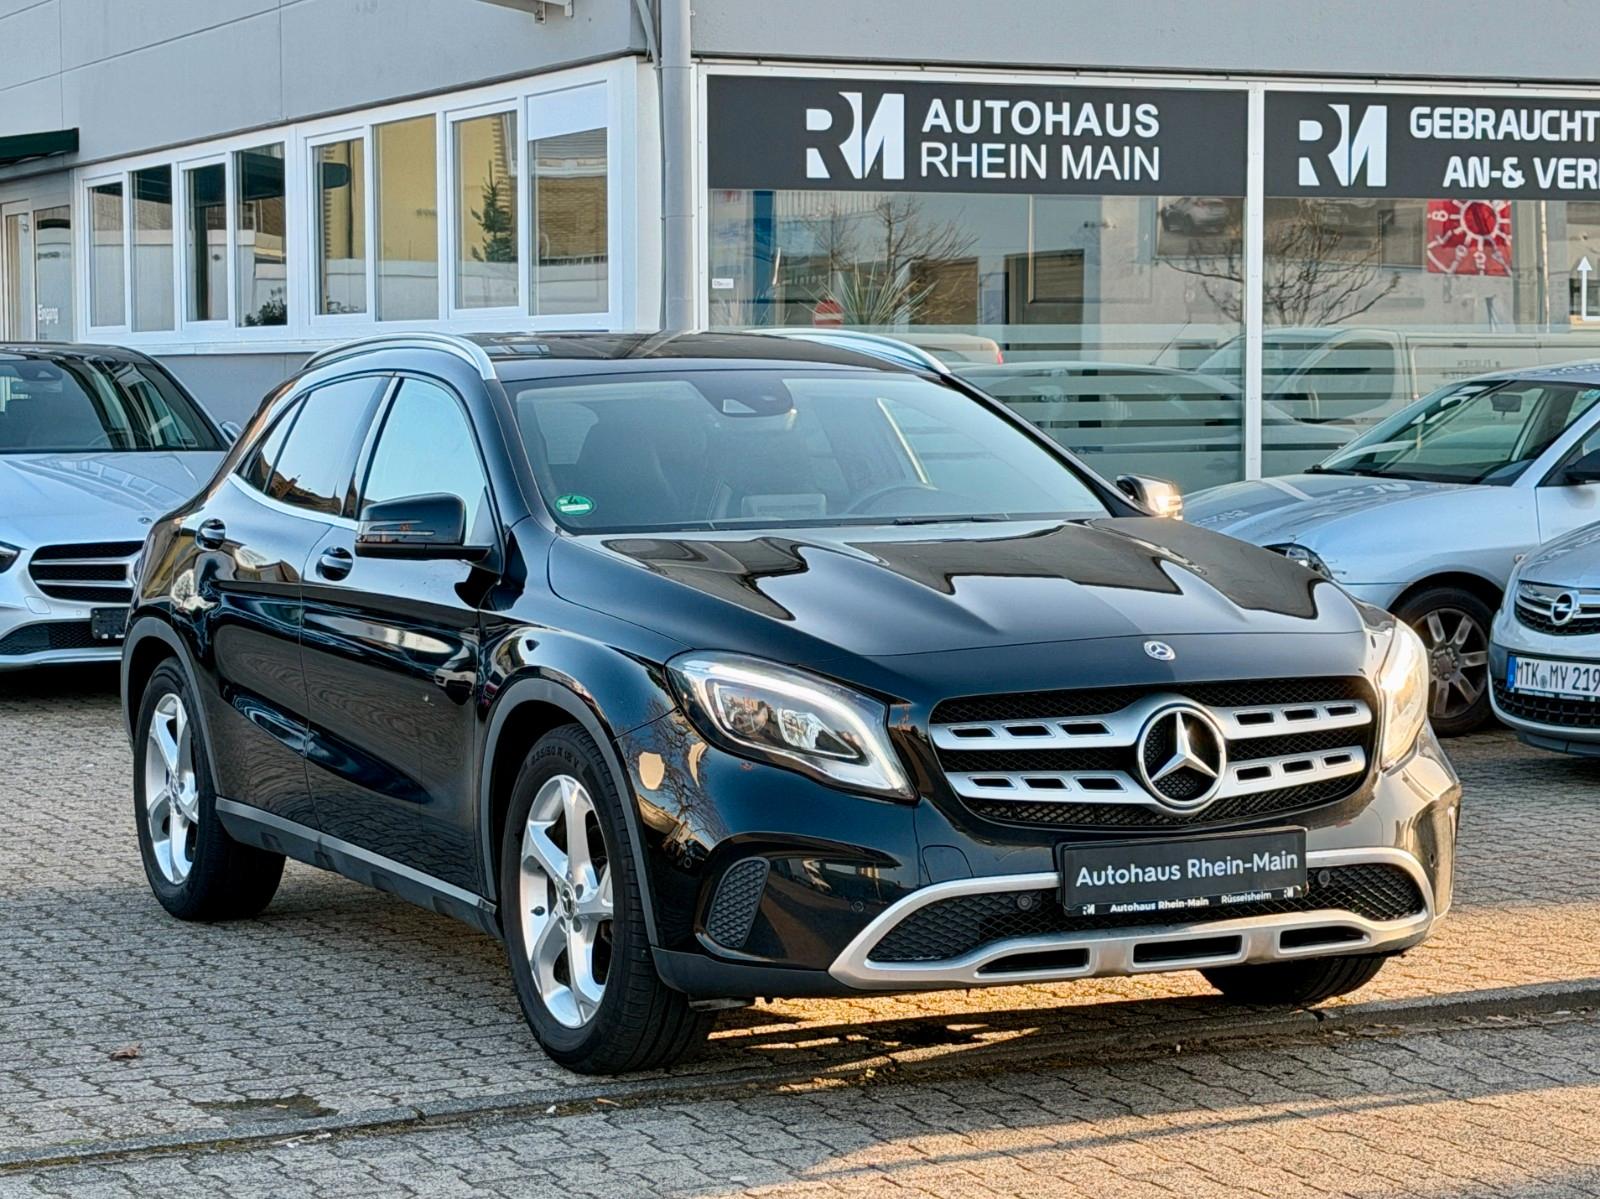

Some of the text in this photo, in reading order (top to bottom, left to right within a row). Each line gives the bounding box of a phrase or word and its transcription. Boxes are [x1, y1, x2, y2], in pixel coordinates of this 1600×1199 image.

[921, 98, 1160, 138] AUTOHAUS
[1409, 106, 1600, 142] GEBRAUCHT
[921, 141, 1160, 181] RHEIN MAIN
[1442, 155, 1600, 190] AN-& VER
[1516, 660, 1540, 687] MTK
[1550, 664, 1569, 689] MY
[1075, 850, 1298, 887] Autohaus Rhein-Main
[1110, 891, 1272, 912] Autohaus Rhein-Main Rüsselsheim
